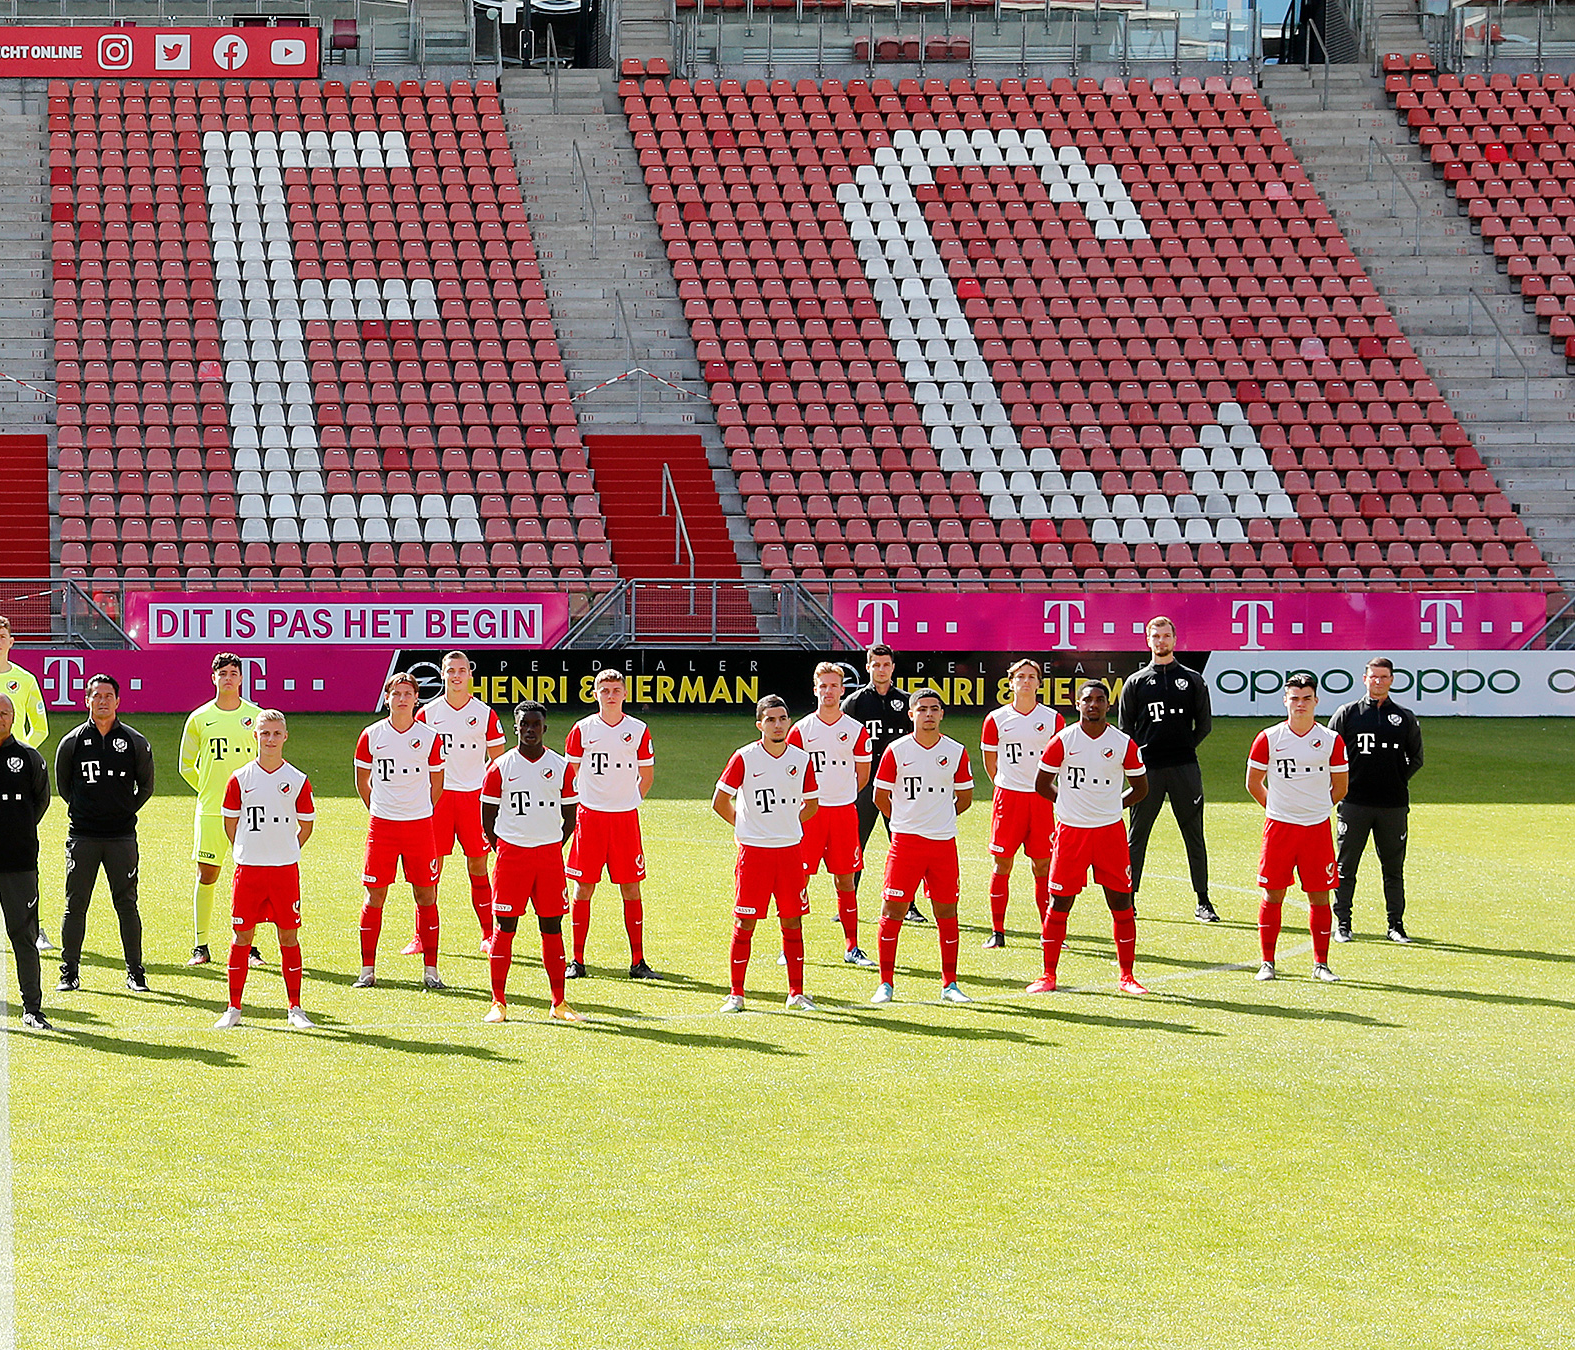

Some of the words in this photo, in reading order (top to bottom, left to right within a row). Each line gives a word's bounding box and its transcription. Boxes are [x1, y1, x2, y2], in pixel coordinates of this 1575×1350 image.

[31, 45, 82, 59] ONLINE
[157, 608, 213, 639] DIT
[225, 608, 256, 639] IS
[268, 608, 333, 639] PAS
[344, 608, 413, 639] HET
[425, 608, 536, 639] BEGIN
[857, 599, 899, 649] T
[1044, 600, 1086, 650] T
[1232, 600, 1274, 650] T
[1420, 600, 1463, 650] T
[43, 656, 84, 705] T
[1147, 701, 1165, 723] T
[865, 719, 882, 740] T
[209, 737, 228, 761] T
[1005, 742, 1022, 765] T
[1357, 732, 1376, 755] T
[81, 760, 100, 784] T
[377, 758, 395, 782] T
[591, 752, 609, 775] T
[809, 750, 826, 773] T
[1276, 757, 1297, 779] T
[903, 776, 922, 801] T
[1067, 766, 1086, 790] T
[510, 791, 531, 817] T
[755, 788, 775, 814] T
[246, 806, 265, 832] T
